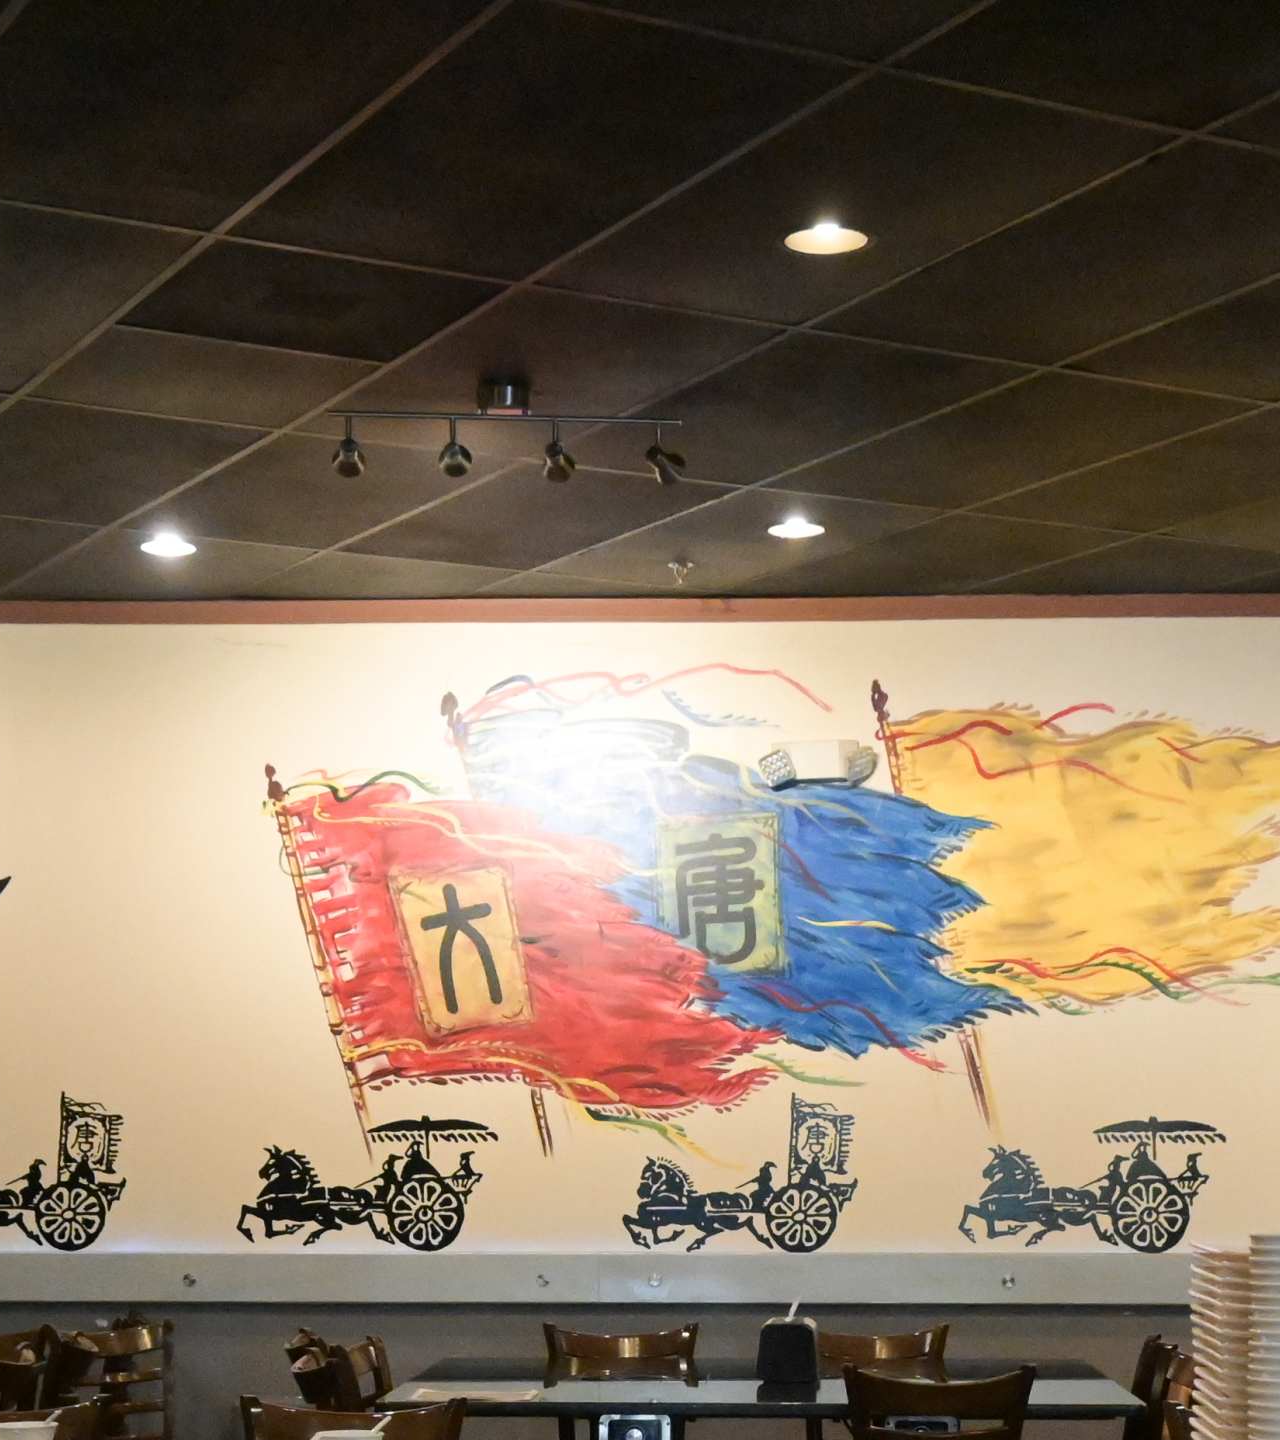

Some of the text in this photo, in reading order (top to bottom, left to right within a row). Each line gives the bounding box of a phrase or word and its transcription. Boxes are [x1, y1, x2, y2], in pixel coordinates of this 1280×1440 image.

[674, 832, 766, 966] 唐
[420, 883, 503, 1014] 大
[71, 1121, 99, 1154] 唐
[801, 1122, 829, 1155] 唐
